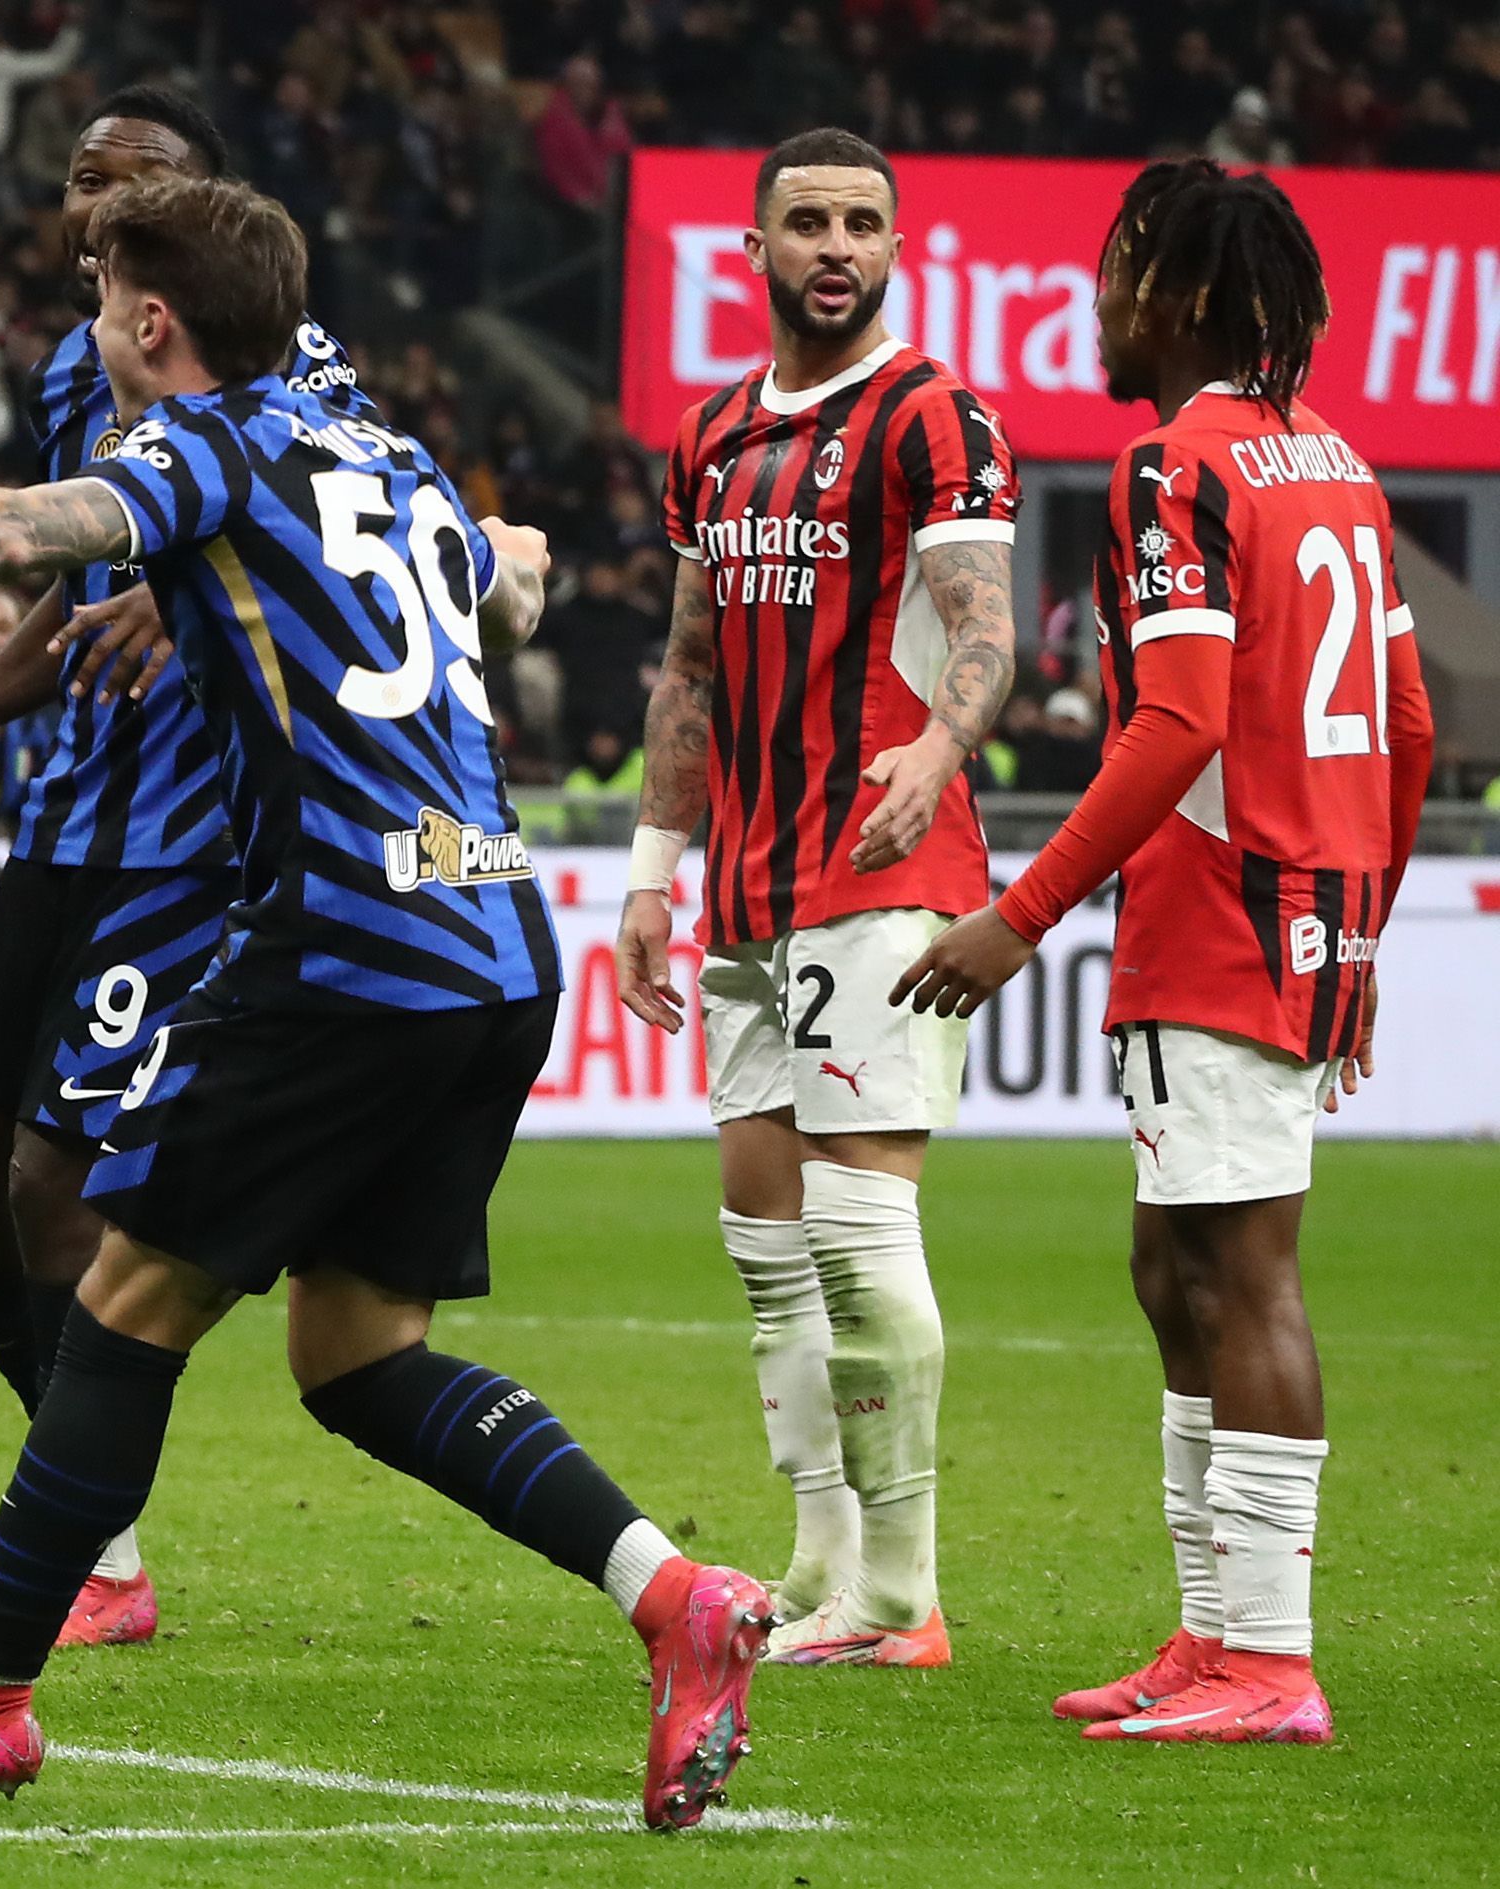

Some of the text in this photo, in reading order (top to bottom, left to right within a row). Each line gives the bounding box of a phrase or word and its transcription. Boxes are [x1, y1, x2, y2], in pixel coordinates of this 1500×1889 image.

[310, 470, 495, 727] 59
[1126, 563, 1205, 605] MSC
[1295, 524, 1390, 758] 21
[88, 964, 149, 1049] 9
[784, 964, 835, 1049] 2
[475, 1388, 538, 1437] INTER
